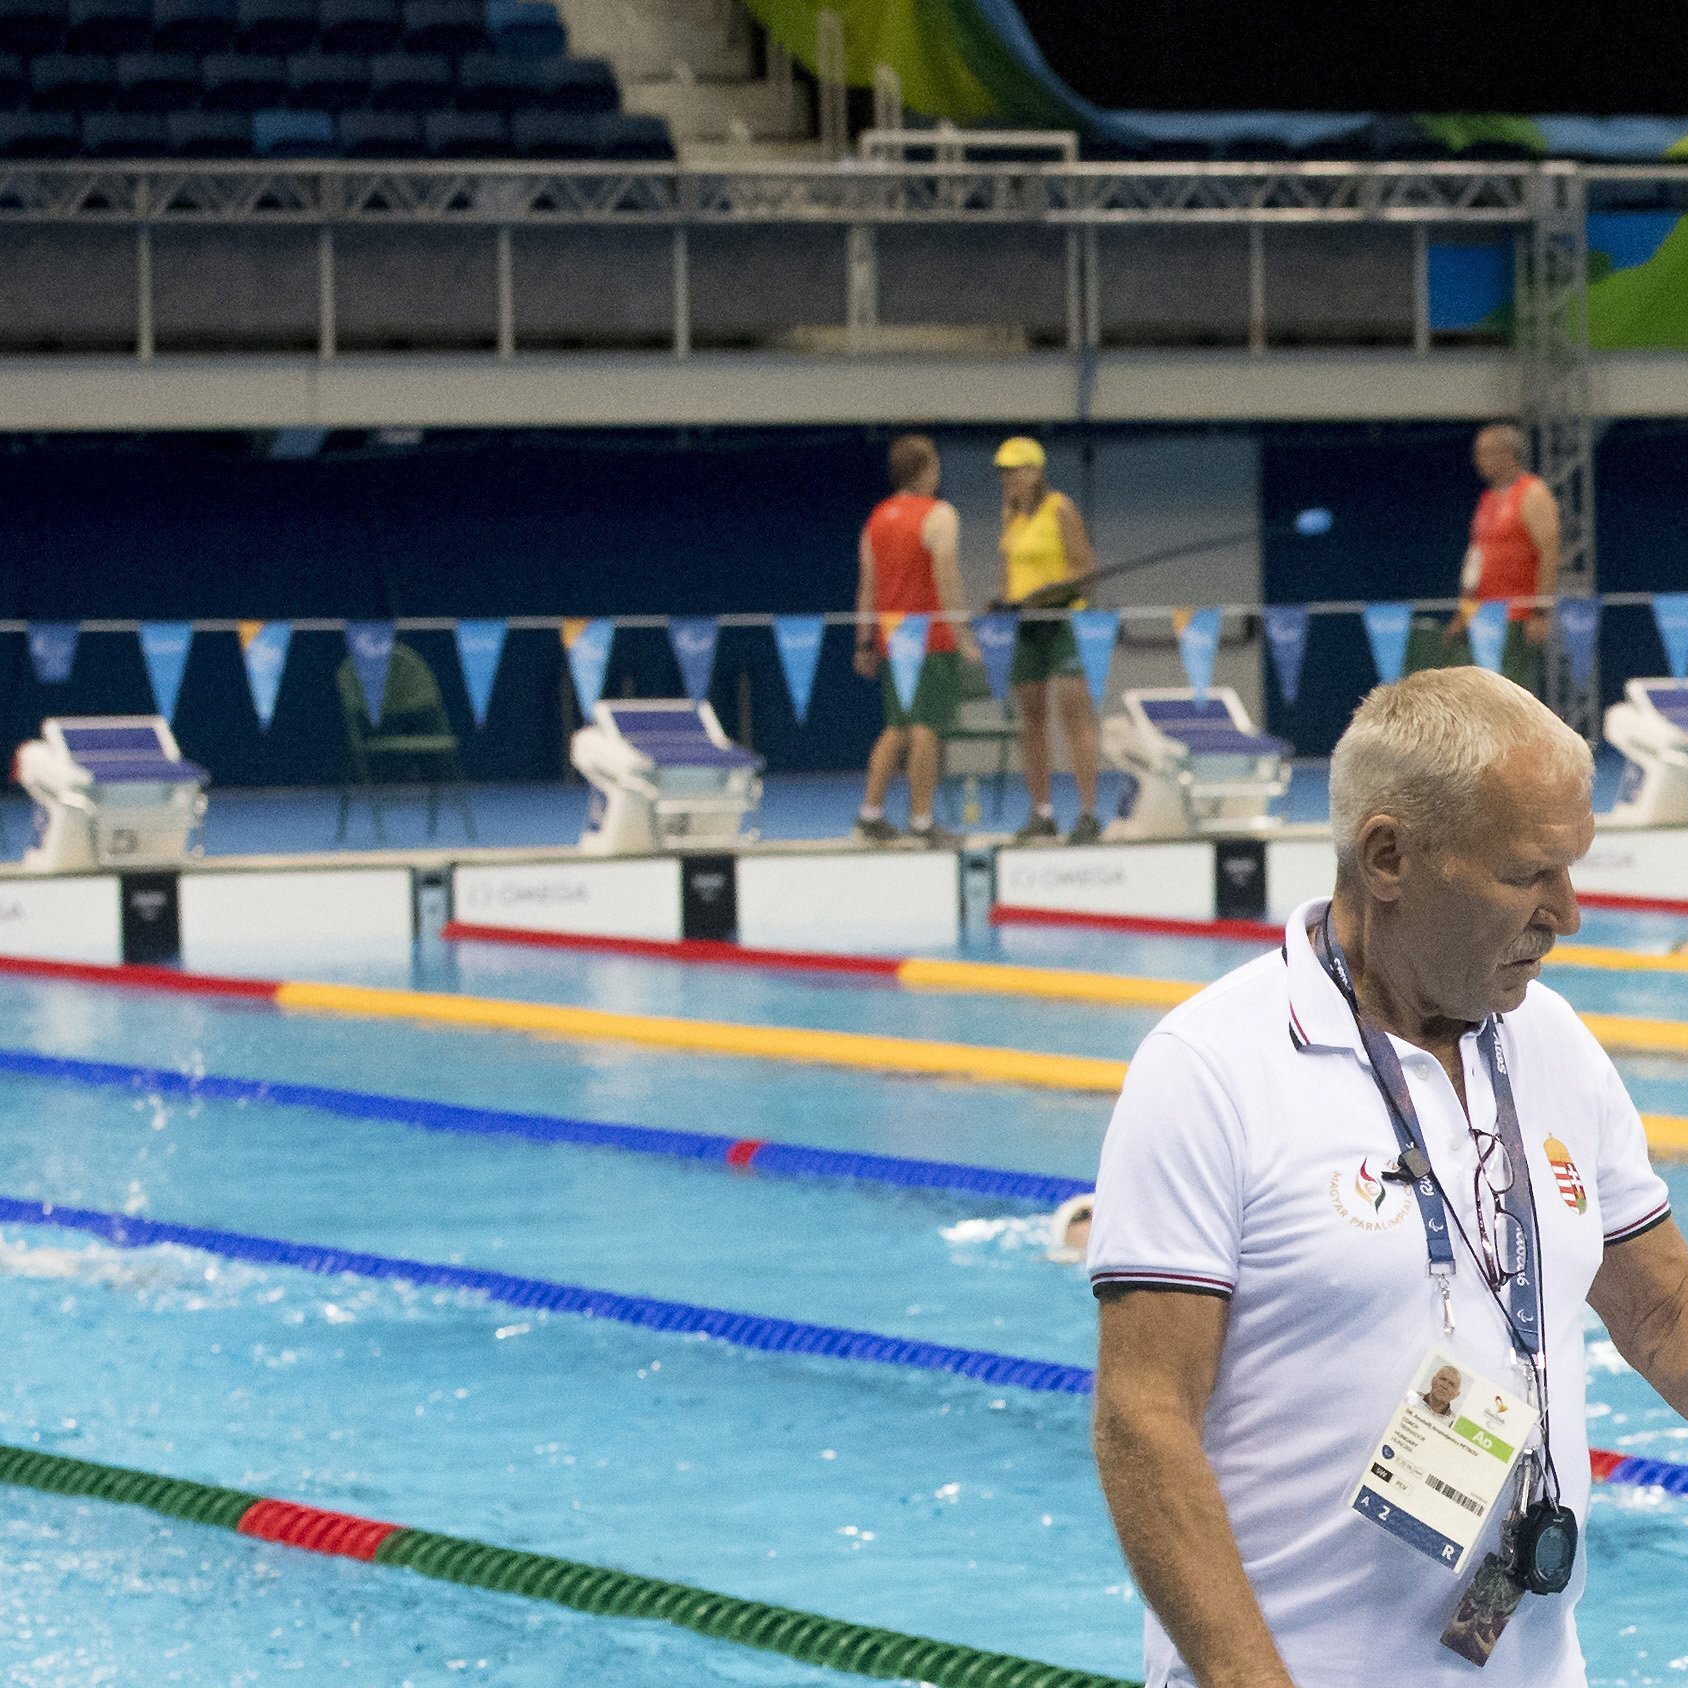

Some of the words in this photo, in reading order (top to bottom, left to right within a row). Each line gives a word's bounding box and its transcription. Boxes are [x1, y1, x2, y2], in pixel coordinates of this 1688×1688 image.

[1360, 1495, 1370, 1507] A
[1378, 1506, 1391, 1521] 2
[1441, 1544, 1455, 1561] R
